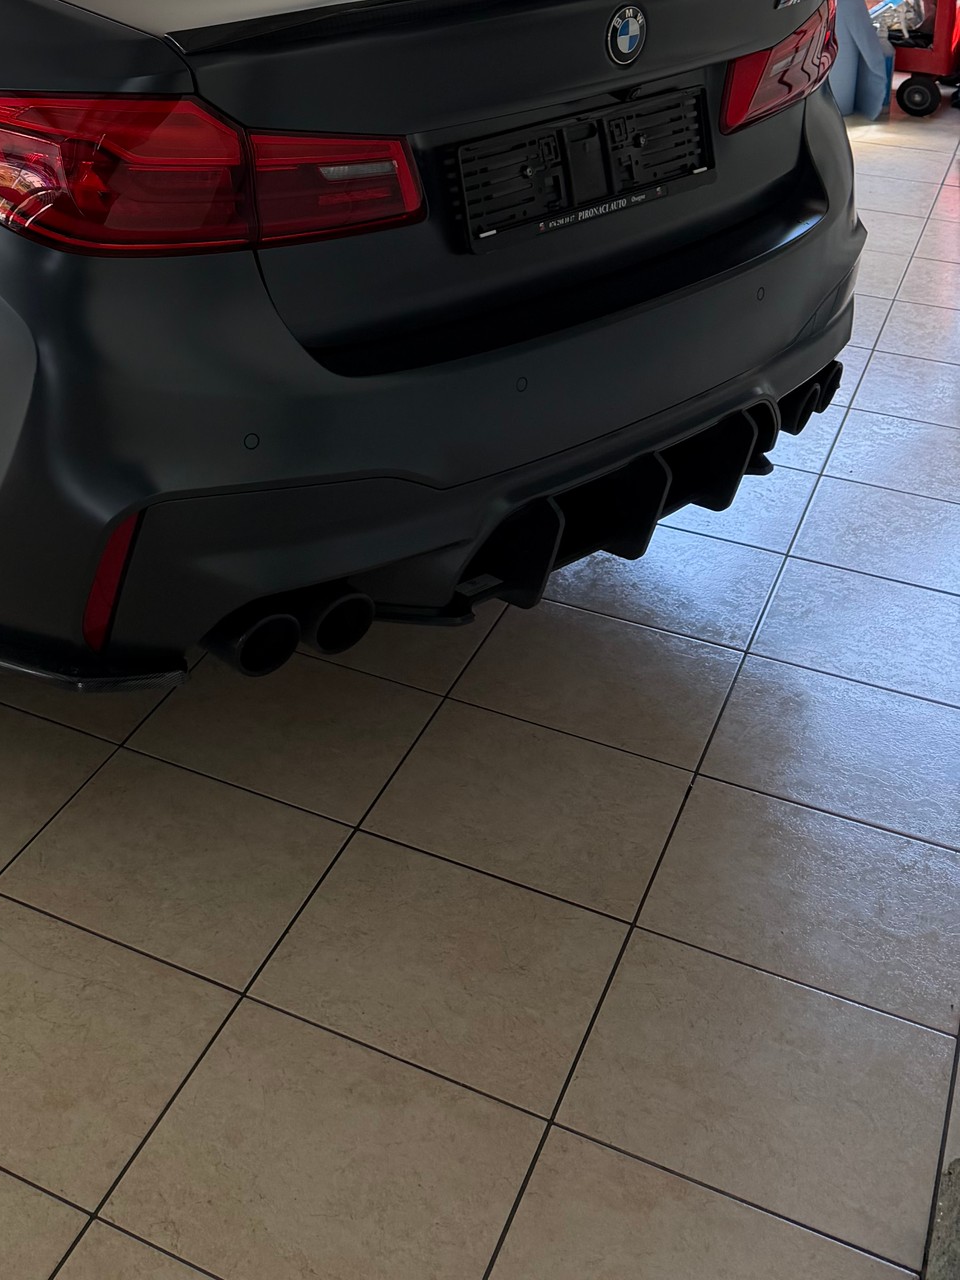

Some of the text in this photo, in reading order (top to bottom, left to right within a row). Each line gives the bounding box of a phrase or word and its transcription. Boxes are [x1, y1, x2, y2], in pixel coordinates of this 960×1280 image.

[613, 8, 645, 28] BMW
[578, 204, 609, 221] PIRONACI
[608, 198, 627, 212] AUTO
